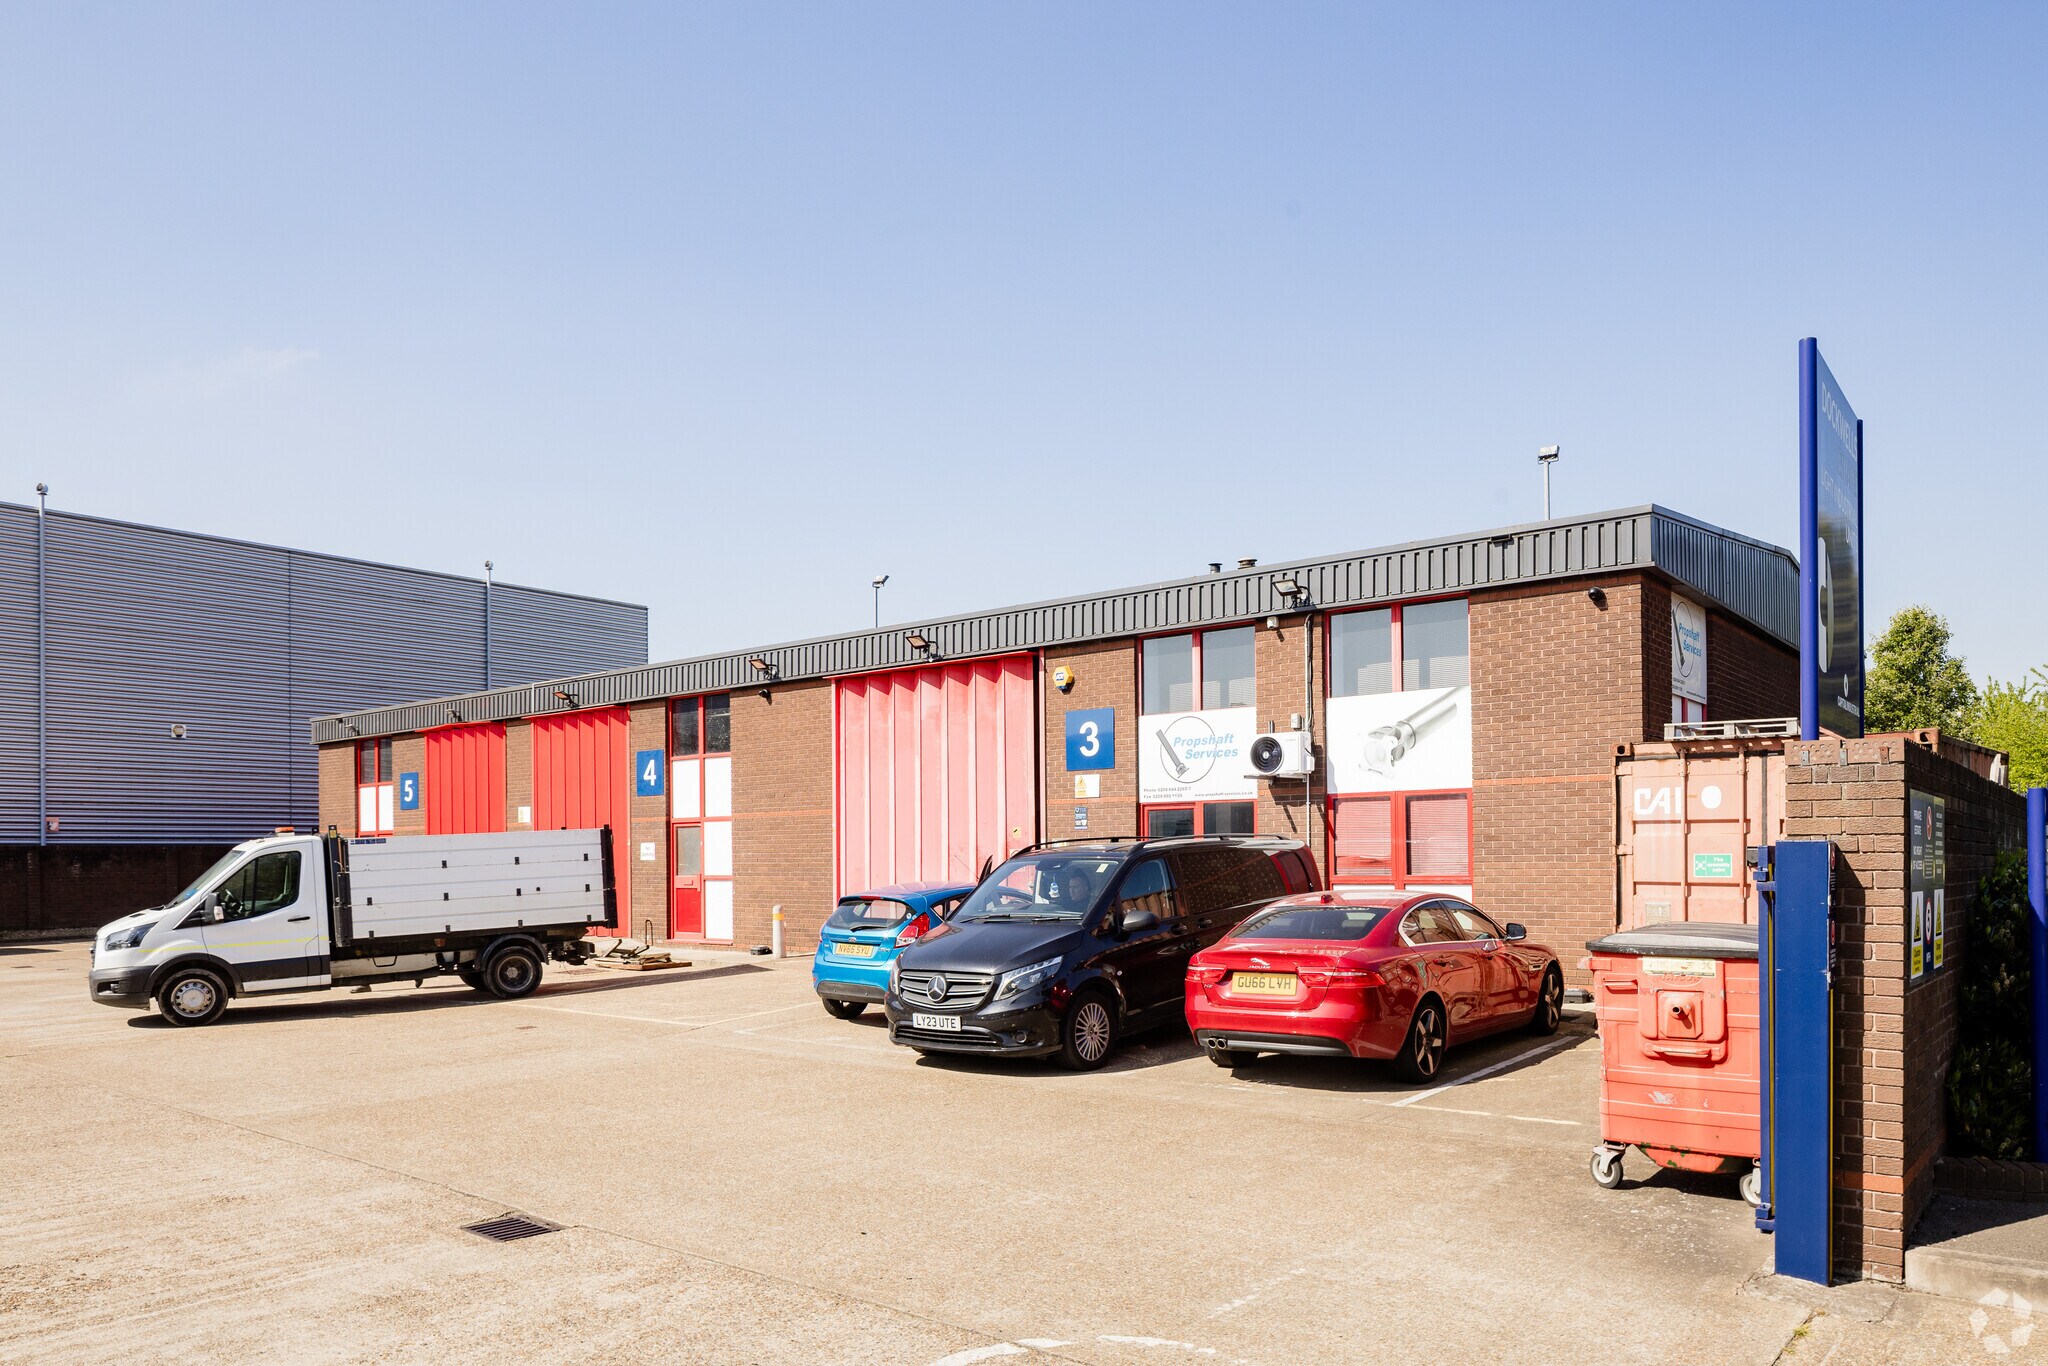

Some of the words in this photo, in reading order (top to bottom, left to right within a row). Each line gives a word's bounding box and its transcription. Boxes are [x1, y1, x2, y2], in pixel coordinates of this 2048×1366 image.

[1822, 382, 1857, 461] DOCKWELLS
[1679, 622, 1700, 642] Propshaft
[1683, 640, 1702, 657] Services
[1079, 721, 1100, 757] 3
[1173, 733, 1234, 748] Propshaft
[1185, 748, 1239, 760] Services
[643, 759, 657, 786] 4
[404, 780, 413, 802] 5
[1634, 786, 1682, 815] CAI
[838, 944, 854, 955] NV65
[1237, 977, 1266, 988] GU66
[1268, 977, 1291, 989] LVH
[916, 1015, 937, 1028] LY23
[938, 1017, 957, 1029] UTE
